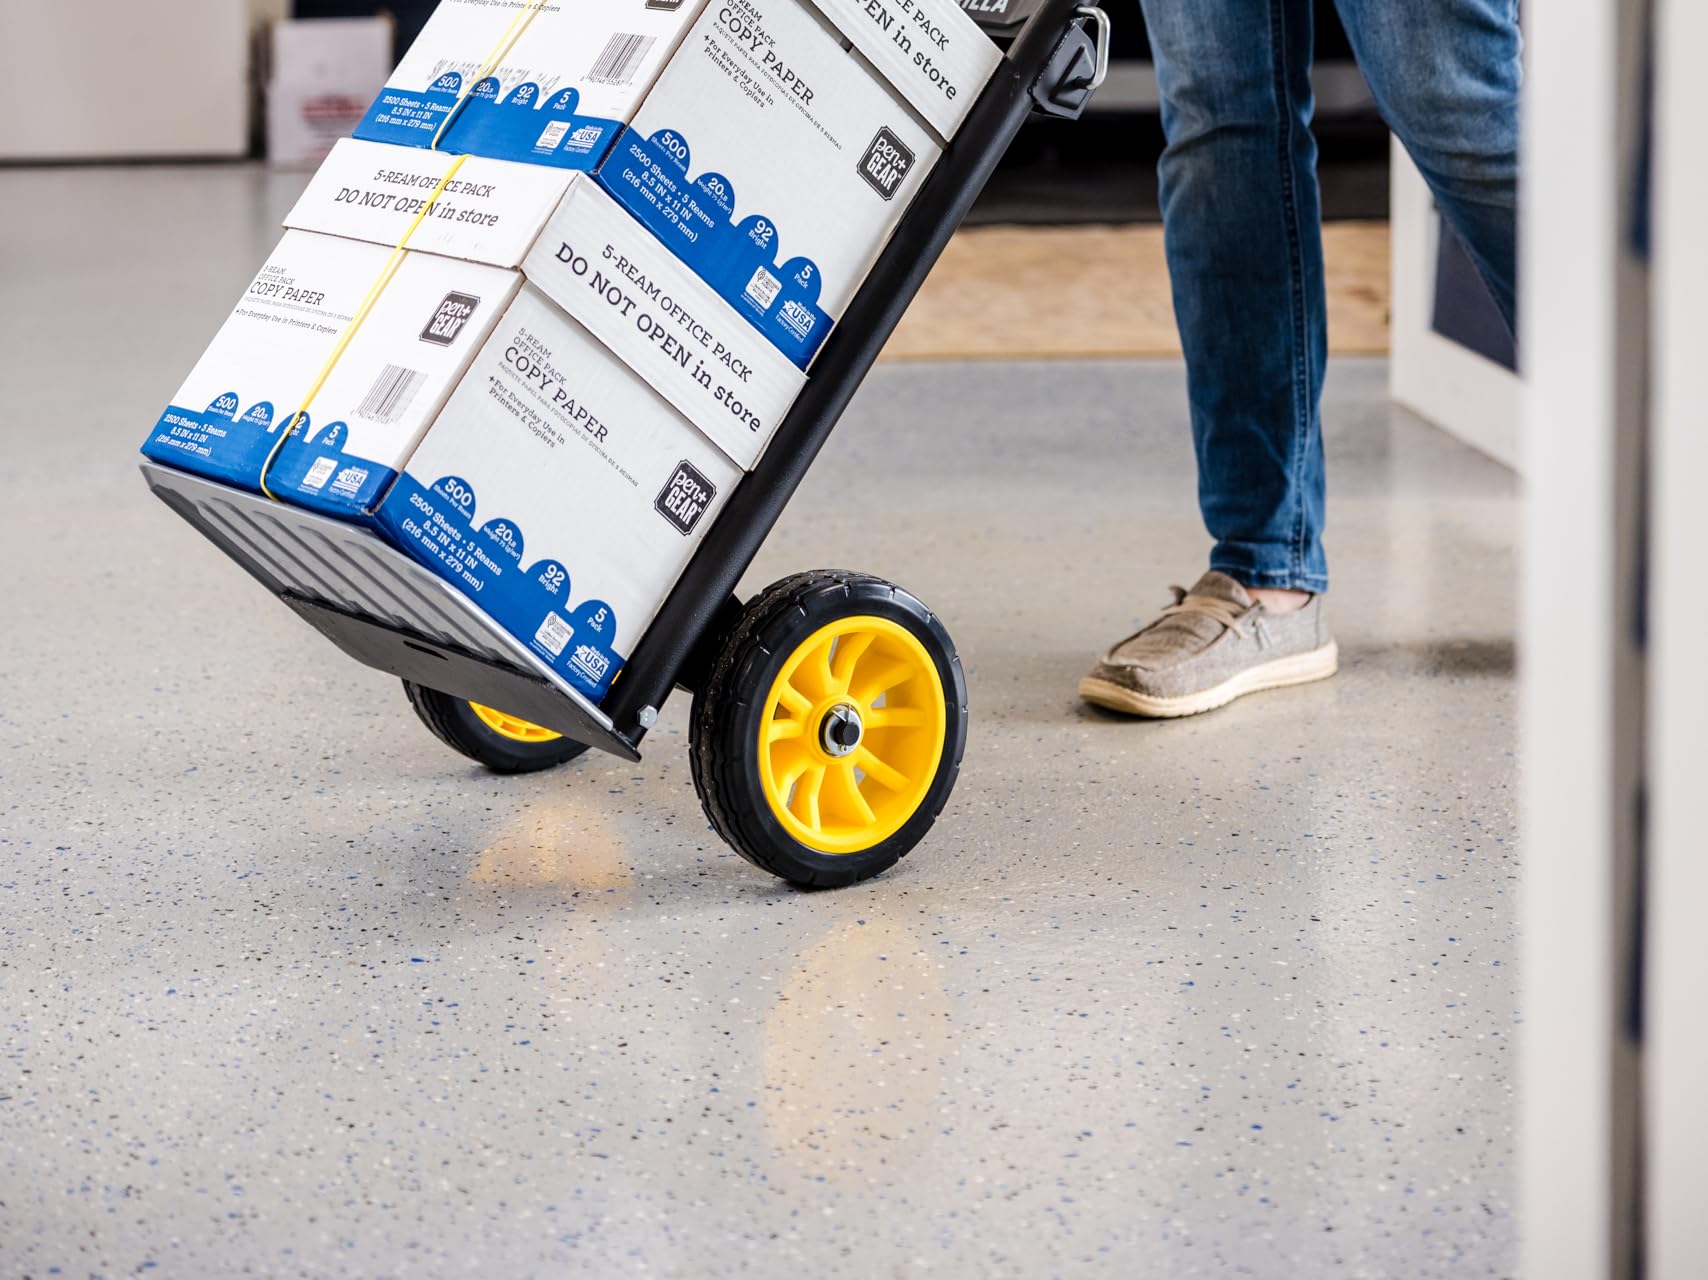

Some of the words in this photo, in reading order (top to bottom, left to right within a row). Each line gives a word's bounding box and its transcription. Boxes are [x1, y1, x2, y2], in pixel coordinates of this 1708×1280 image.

[754, 25, 776, 48] PACK
[912, 9, 949, 51] PACK
[719, 8, 763, 52] COPY
[762, 50, 814, 106] PAPER
[892, 25, 911, 54] in
[913, 52, 956, 100] store
[438, 75, 459, 88] 500
[704, 46, 732, 76] Printers
[732, 75, 739, 83] &
[739, 81, 765, 108] Copiers
[709, 39, 722, 53] For
[721, 51, 752, 84] Everyday
[753, 81, 766, 97] Use
[765, 94, 774, 105] in
[382, 95, 401, 105] 2500
[399, 97, 421, 108] Sheets
[424, 102, 431, 110] 5
[429, 102, 452, 113] Reams
[517, 85, 534, 98] 92
[560, 91, 571, 104] 5
[389, 117, 403, 125] mm
[391, 106, 404, 115] 8.5
[401, 108, 412, 116] IN
[422, 111, 433, 119] IN
[579, 131, 598, 142] USA
[662, 132, 687, 159] 500
[871, 136, 906, 178] pen+
[373, 169, 421, 186] 5-REAM
[460, 182, 496, 198] PACK
[867, 152, 898, 190] GEAR
[629, 144, 651, 167] 2500
[650, 164, 677, 192] Sheets
[681, 194, 690, 203] 5
[688, 200, 715, 228] Reams
[641, 171, 656, 187] 8.5
[654, 183, 667, 197] IN
[665, 194, 672, 203] x
[672, 200, 681, 211] 11
[680, 207, 692, 221] IN
[334, 187, 360, 204] DO
[358, 191, 397, 209] NOT
[394, 197, 441, 216] OPEN
[437, 202, 456, 220] in
[456, 209, 499, 227] store
[622, 168, 641, 188] (216
[640, 186, 656, 204] mm
[656, 201, 663, 210] x
[662, 206, 679, 223] 279
[677, 221, 698, 243] mm)
[748, 229, 767, 249] Bright
[754, 220, 773, 242] 92
[794, 273, 808, 288] Pack
[801, 265, 813, 279] 5
[250, 281, 285, 297] COPY
[282, 287, 325, 306] PAPER
[435, 300, 471, 322] pen+
[602, 244, 661, 302] 5-REAM
[660, 296, 713, 348] OFFICE
[712, 342, 752, 383] PACK
[792, 307, 811, 331] USA
[429, 315, 462, 338] GEAR
[555, 242, 588, 276] DO
[589, 271, 636, 316] NOT
[637, 314, 692, 368] OPEN
[691, 360, 712, 390] in
[714, 386, 761, 432] store
[518, 327, 552, 359] 5-REAM
[513, 336, 544, 365] OFFICE
[543, 362, 567, 385] PACK
[216, 395, 236, 410] 500
[505, 346, 553, 390] COPY
[552, 388, 608, 443] PAPER
[489, 387, 520, 417] Printers
[520, 415, 527, 423] &
[528, 421, 555, 448] Copiers
[494, 379, 508, 393] For
[508, 392, 542, 424] Everyday
[542, 421, 556, 437] Use
[556, 433, 565, 445] in
[178, 417, 199, 429] Sheets
[205, 425, 227, 438] Reams
[329, 425, 341, 439] 5
[345, 472, 363, 485] USA
[670, 470, 707, 512] pen+
[445, 479, 472, 506] 500
[665, 486, 698, 525] GEAR
[410, 493, 434, 516] 2500
[432, 512, 462, 541] Sheets
[467, 541, 475, 551] 5
[473, 547, 502, 576] Reams
[423, 520, 439, 536] 8.5
[437, 532, 451, 546] IN
[448, 543, 456, 553] x
[456, 548, 466, 560] 11
[464, 555, 478, 569] IN
[402, 518, 422, 538] (216
[421, 536, 439, 554] mm
[438, 551, 447, 560] x
[445, 555, 463, 573] 279
[462, 570, 484, 592] mm)
[538, 574, 558, 594] Bright
[544, 564, 565, 587] 92
[587, 617, 602, 633] Pack
[595, 607, 607, 623] 5
[584, 652, 605, 675] USA
